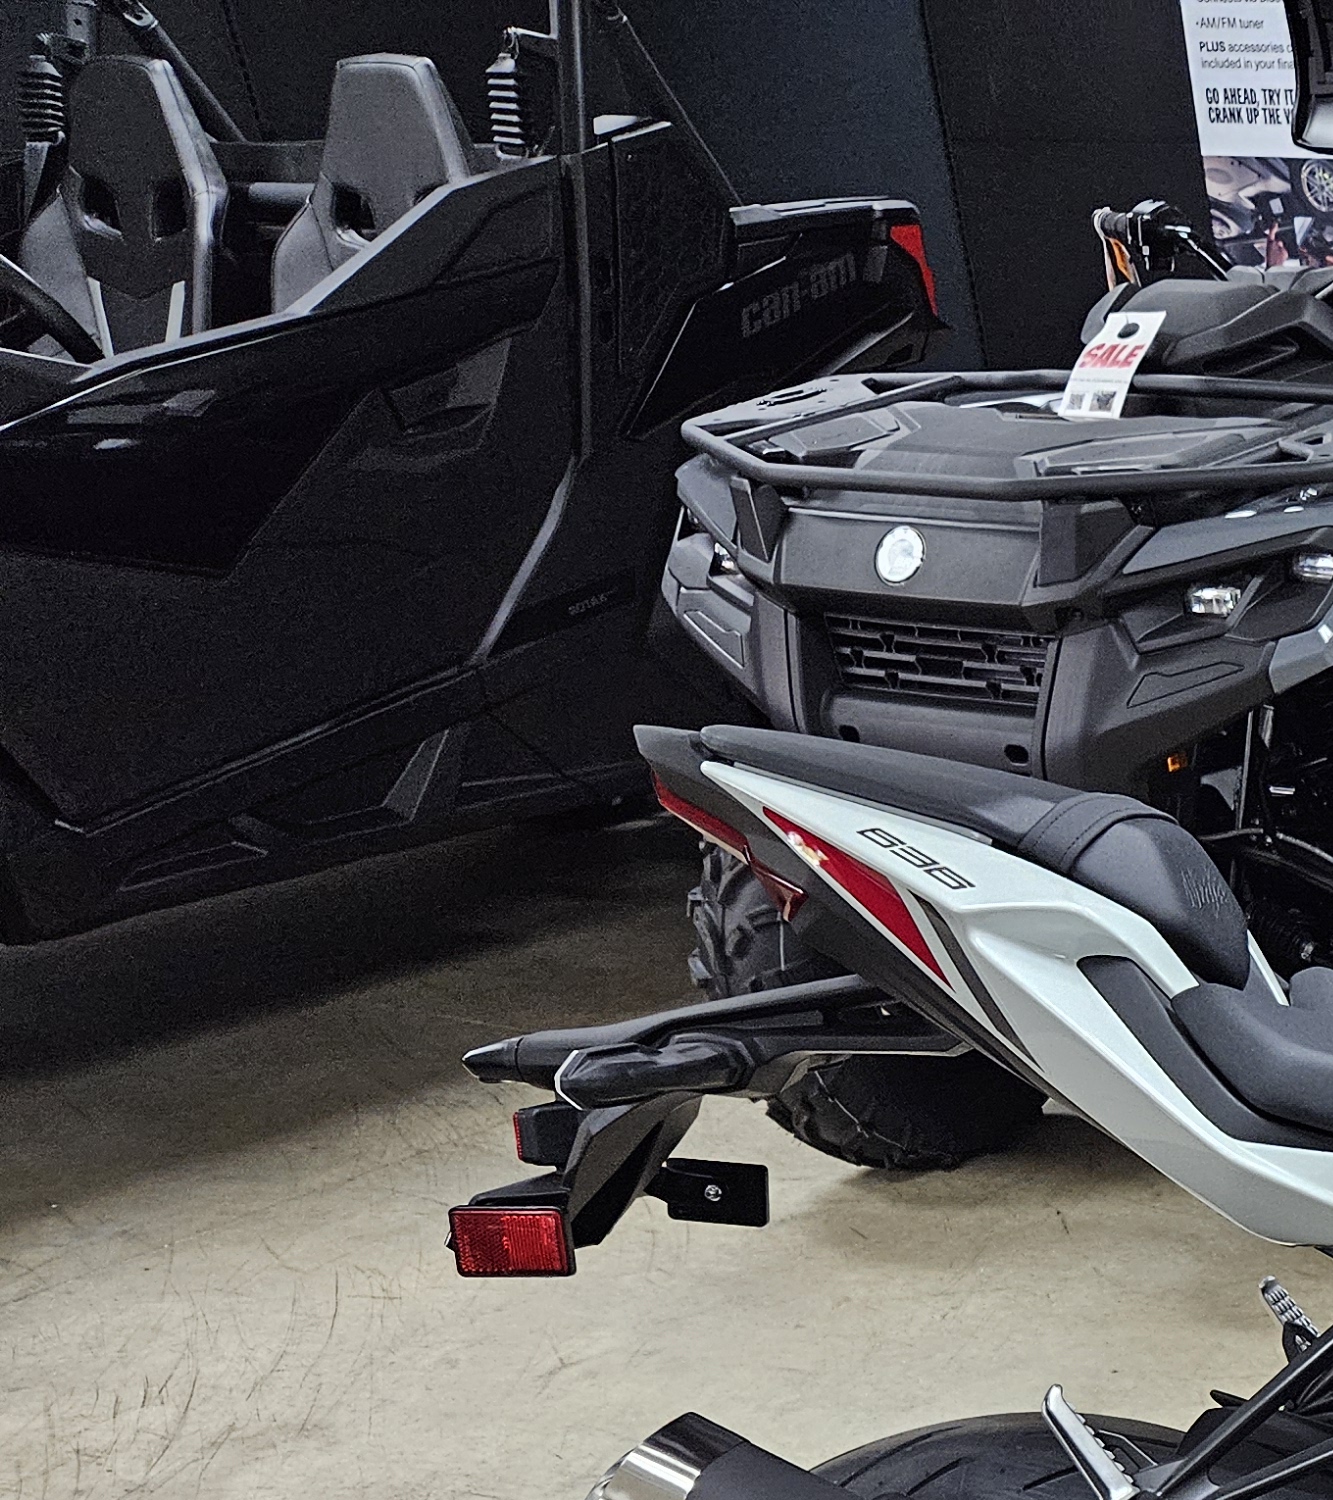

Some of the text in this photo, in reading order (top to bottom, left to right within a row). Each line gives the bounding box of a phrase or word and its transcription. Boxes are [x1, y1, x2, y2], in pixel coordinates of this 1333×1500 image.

[1200, 17, 1264, 29] AM/FM tuner
[1199, 41, 1226, 53] PLUS
[1228, 42, 1285, 54] accessories
[1200, 58, 1242, 69] included
[1243, 58, 1253, 69] in
[1255, 60, 1275, 72] your
[1205, 87, 1220, 105] GO
[1223, 88, 1260, 108] AHEAD,
[1261, 88, 1281, 106] TRY
[1208, 106, 1244, 124] CRANK
[1246, 107, 1260, 125] UP
[1261, 107, 1283, 125] THE
[1079, 342, 1146, 369] SALE
[856, 827, 977, 890] 636
